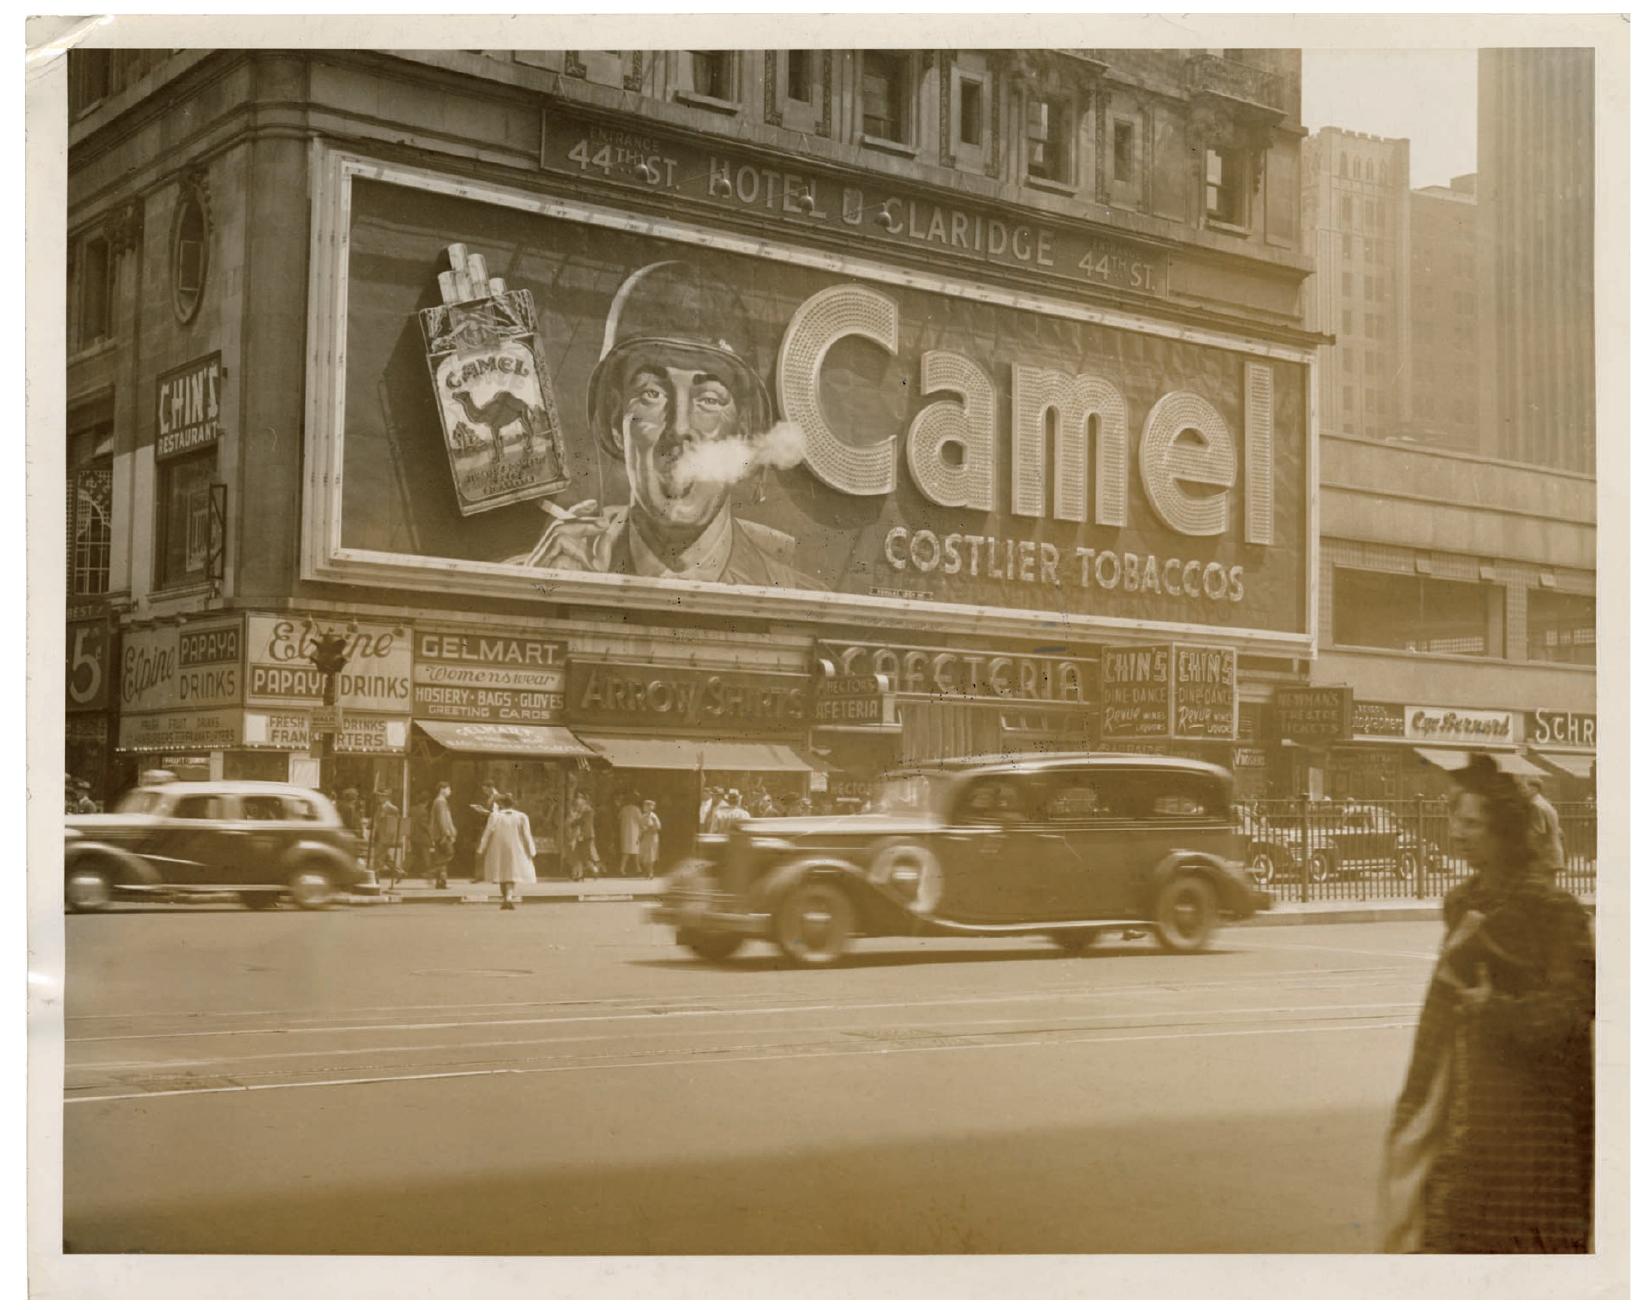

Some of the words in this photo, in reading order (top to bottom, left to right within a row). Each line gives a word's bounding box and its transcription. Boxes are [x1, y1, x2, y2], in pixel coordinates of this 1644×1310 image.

[709, 156, 826, 218] HOTEL
[883, 198, 1054, 267] CLARIDGE
[1130, 261, 1155, 291] ST.
[446, 356, 530, 389] CAMEL
[159, 363, 218, 435] CHIN'S
[777, 283, 1274, 545] Camel
[158, 421, 217, 455] RESTAURANT
[886, 526, 1059, 587] COSTLIER
[1077, 547, 1245, 602] TOBACCOS
[180, 632, 237, 663] PAPAYA
[269, 620, 394, 662] Elne
[421, 635, 560, 665] GELMART
[123, 646, 176, 704] Elpine
[841, 647, 1084, 704] CAFETERIA
[1104, 647, 1167, 683] CHIN'S
[1178, 649, 1233, 685] CHIN'S
[180, 670, 236, 700] DRINKS
[341, 675, 409, 699] DRINKS
[415, 687, 470, 704] HOSIERY
[478, 690, 512, 707] BAGS
[520, 693, 564, 709] GLOVES
[270, 715, 304, 728] FRESH
[343, 718, 387, 732] DRINKS
[428, 705, 491, 717] GREETING
[499, 708, 553, 720] CARDS
[815, 700, 878, 719] AFETERIA
[1279, 710, 1339, 721] THEATRE
[1281, 723, 1340, 734] TICKETS
